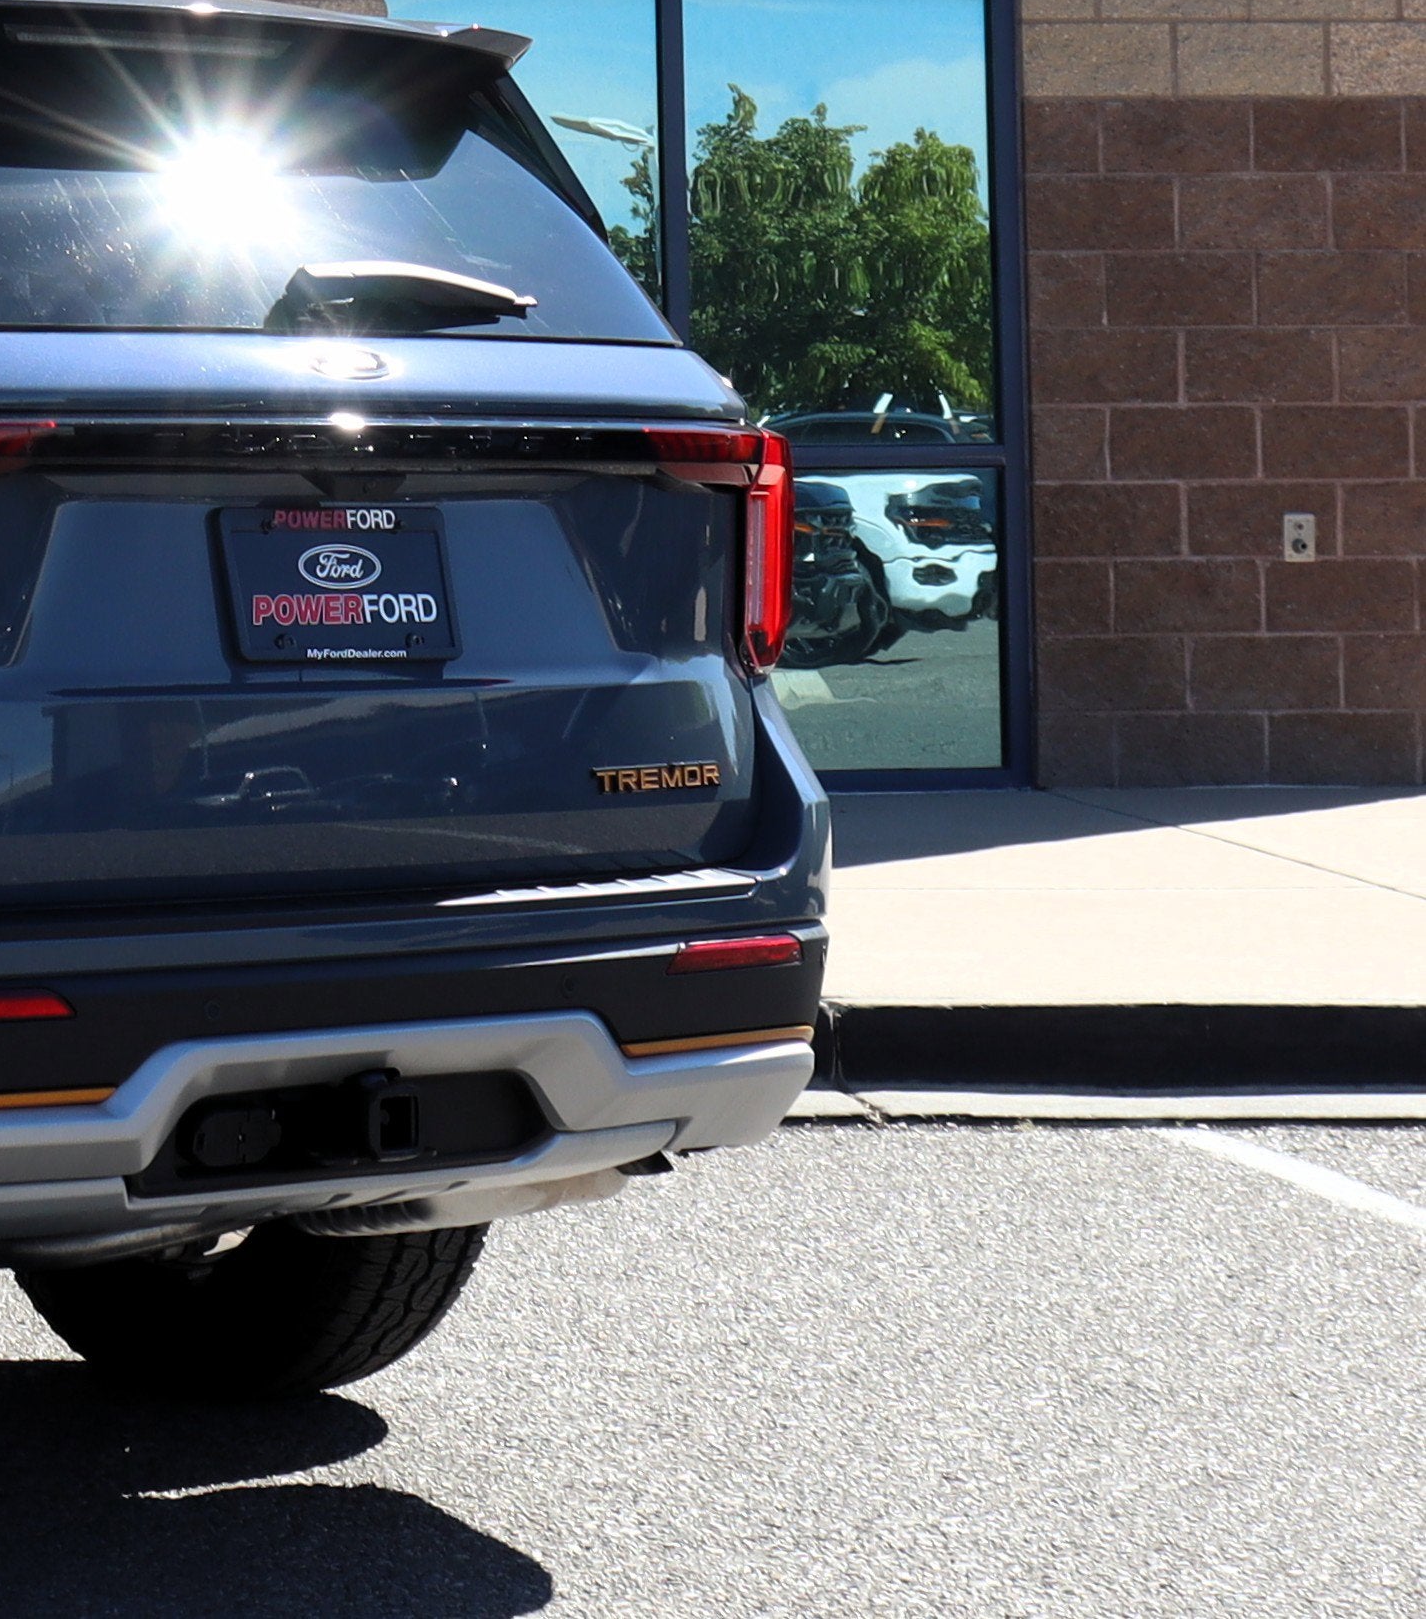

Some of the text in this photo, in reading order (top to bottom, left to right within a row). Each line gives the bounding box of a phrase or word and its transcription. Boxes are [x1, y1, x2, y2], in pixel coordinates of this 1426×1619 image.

[315, 552, 364, 579] Ford
[306, 648, 407, 660] MyFordDealer.com
[595, 762, 722, 793] TREMOR
